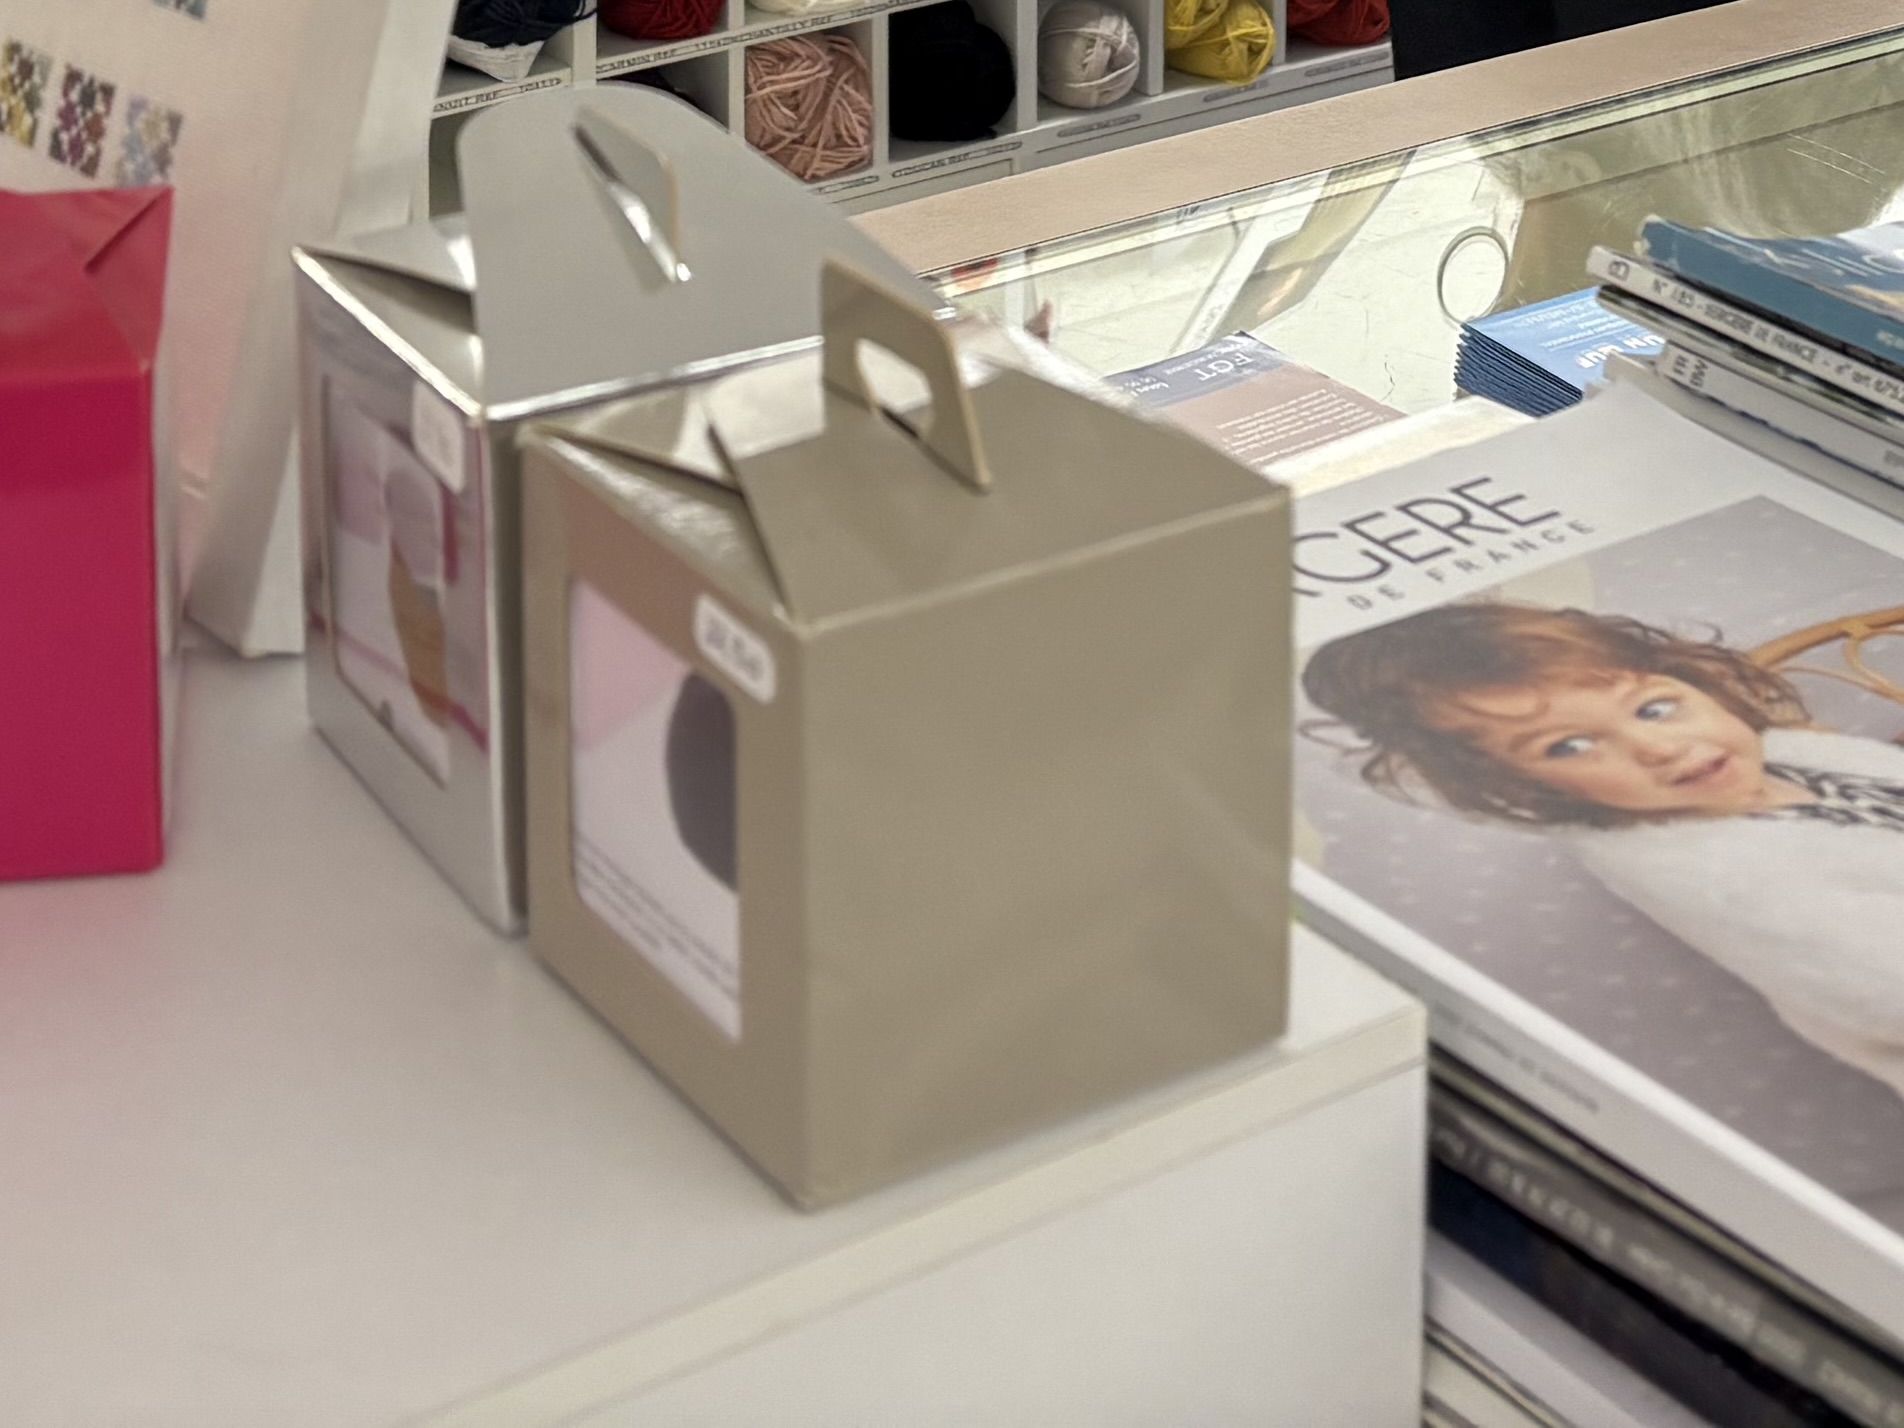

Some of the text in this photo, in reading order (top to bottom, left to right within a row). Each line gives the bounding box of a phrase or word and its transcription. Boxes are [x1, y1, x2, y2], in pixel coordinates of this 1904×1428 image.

[1292, 476, 1562, 596] GERE
[1346, 520, 1596, 611] DE FRANCE
